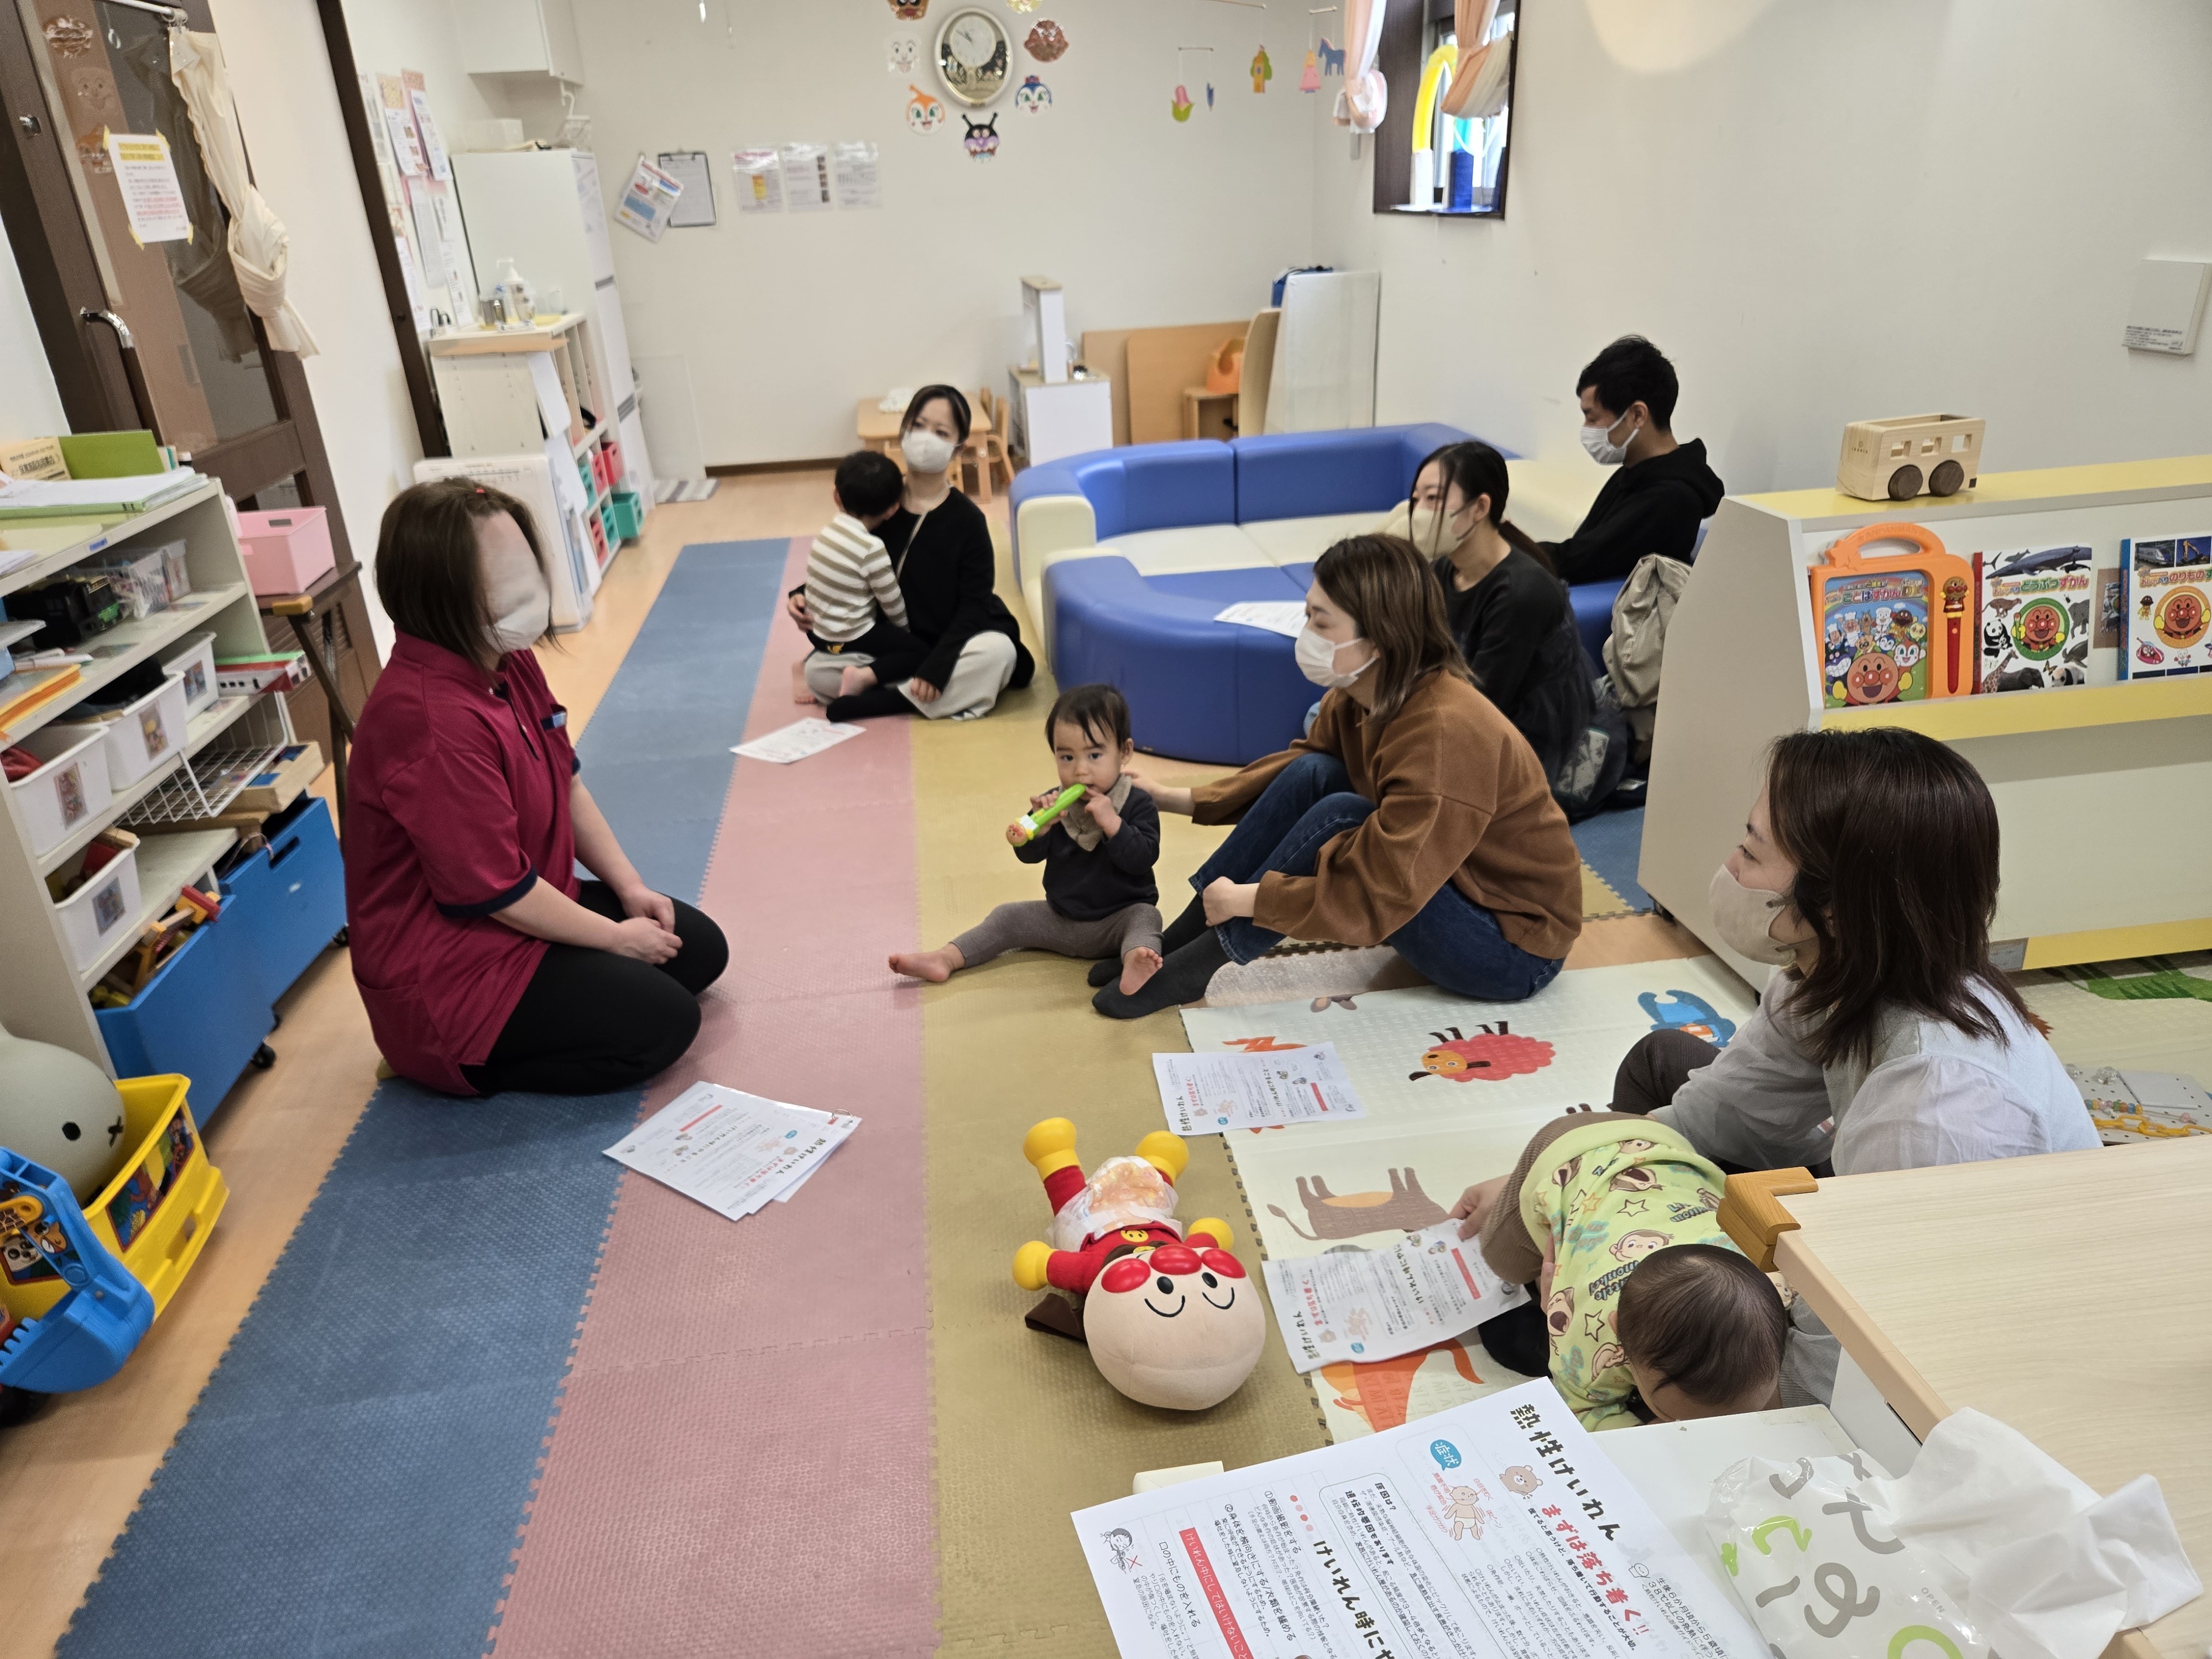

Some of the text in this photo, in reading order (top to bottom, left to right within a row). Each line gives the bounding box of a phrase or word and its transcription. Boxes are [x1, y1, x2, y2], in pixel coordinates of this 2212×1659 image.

[1902, 585, 1923, 598] DX
[2020, 576, 2089, 592] どうぶつずかん
[1434, 1438, 1458, 1470] 症状
[1510, 1404, 1620, 1541] 熱性けいれん
[1264, 1490, 1301, 1553] ①動画撮影をする
[1344, 1490, 1394, 1564] 遺伝的要因もあります
[1374, 1482, 1396, 1510] 原因は？
[1159, 1541, 1201, 1627] 口の中にものを入れる
[1186, 1533, 1246, 1659] けいれん中にしてはいけないこと
[1221, 1517, 1266, 1609] 楽に呼吸ができるようにするため、
[1224, 1504, 1296, 1641] ②身体を横向きにする/衣類を緩める
[1648, 1581, 1717, 1659] 38℃以上の発熱に伴う
[1921, 1587, 1945, 1614] OPEN
